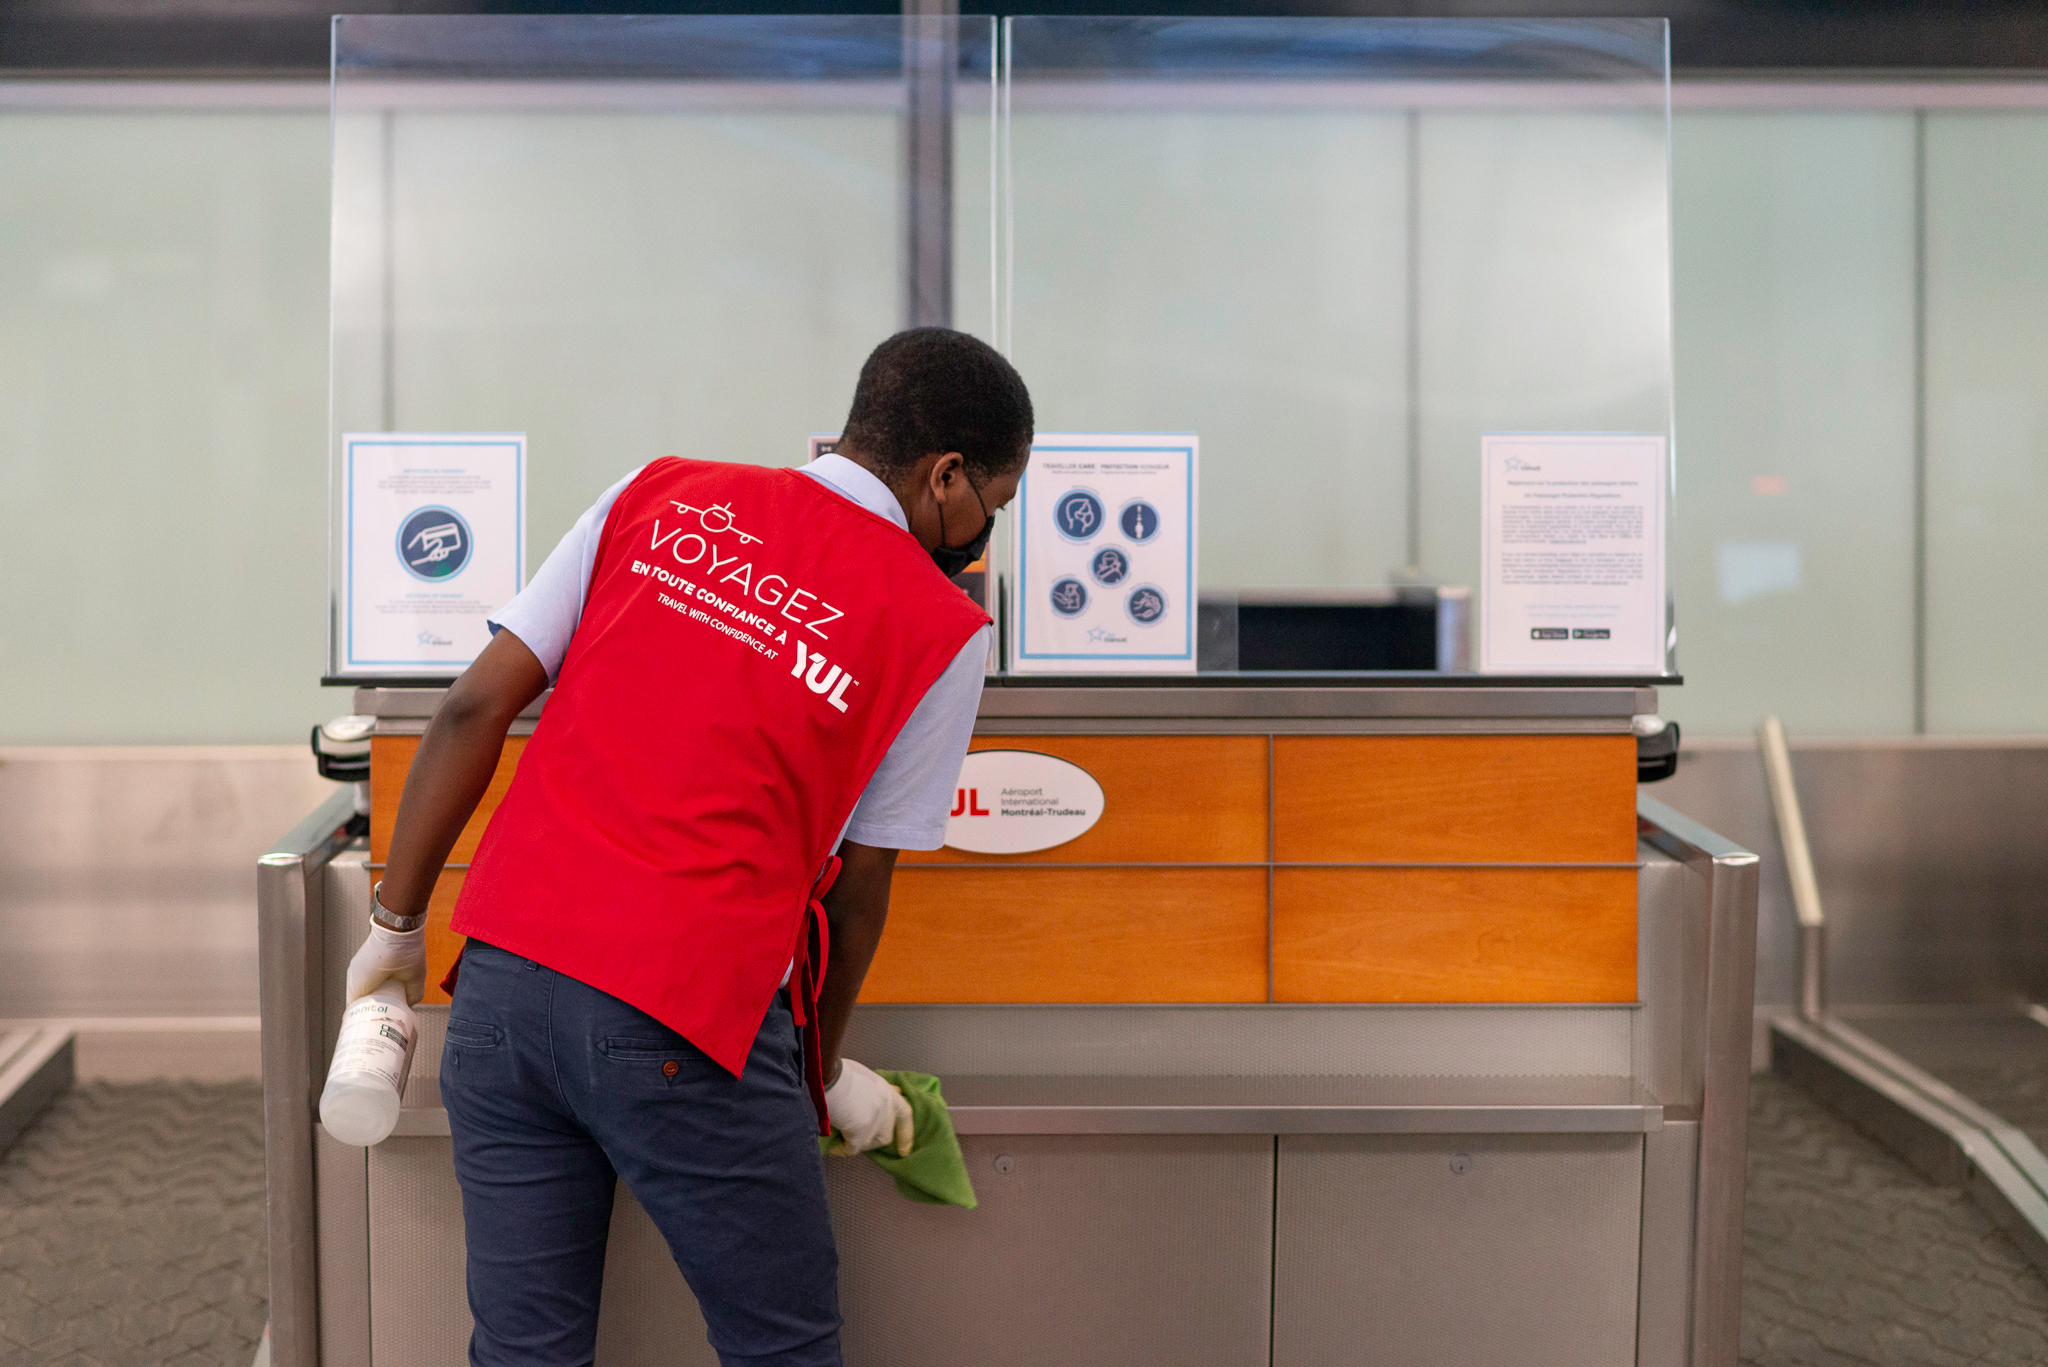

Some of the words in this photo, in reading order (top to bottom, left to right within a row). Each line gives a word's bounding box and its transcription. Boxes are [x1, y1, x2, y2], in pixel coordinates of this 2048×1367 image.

[630, 559, 651, 576] EN
[651, 567, 696, 596] TOUTE
[696, 588, 777, 637] CONFIANCE
[775, 630, 788, 645] À
[650, 519, 845, 641] VOYAGEZ
[657, 592, 688, 615] TRAVEL
[688, 607, 711, 625] WITH
[709, 618, 766, 654] CONFIDENCE
[764, 648, 779, 660] AT
[790, 639, 853, 714] YUL
[950, 788, 990, 817] UL
[1001, 788, 1043, 797] Aéroport
[1001, 798, 1059, 806] International
[1001, 808, 1086, 816] Montréal-Trudeau
